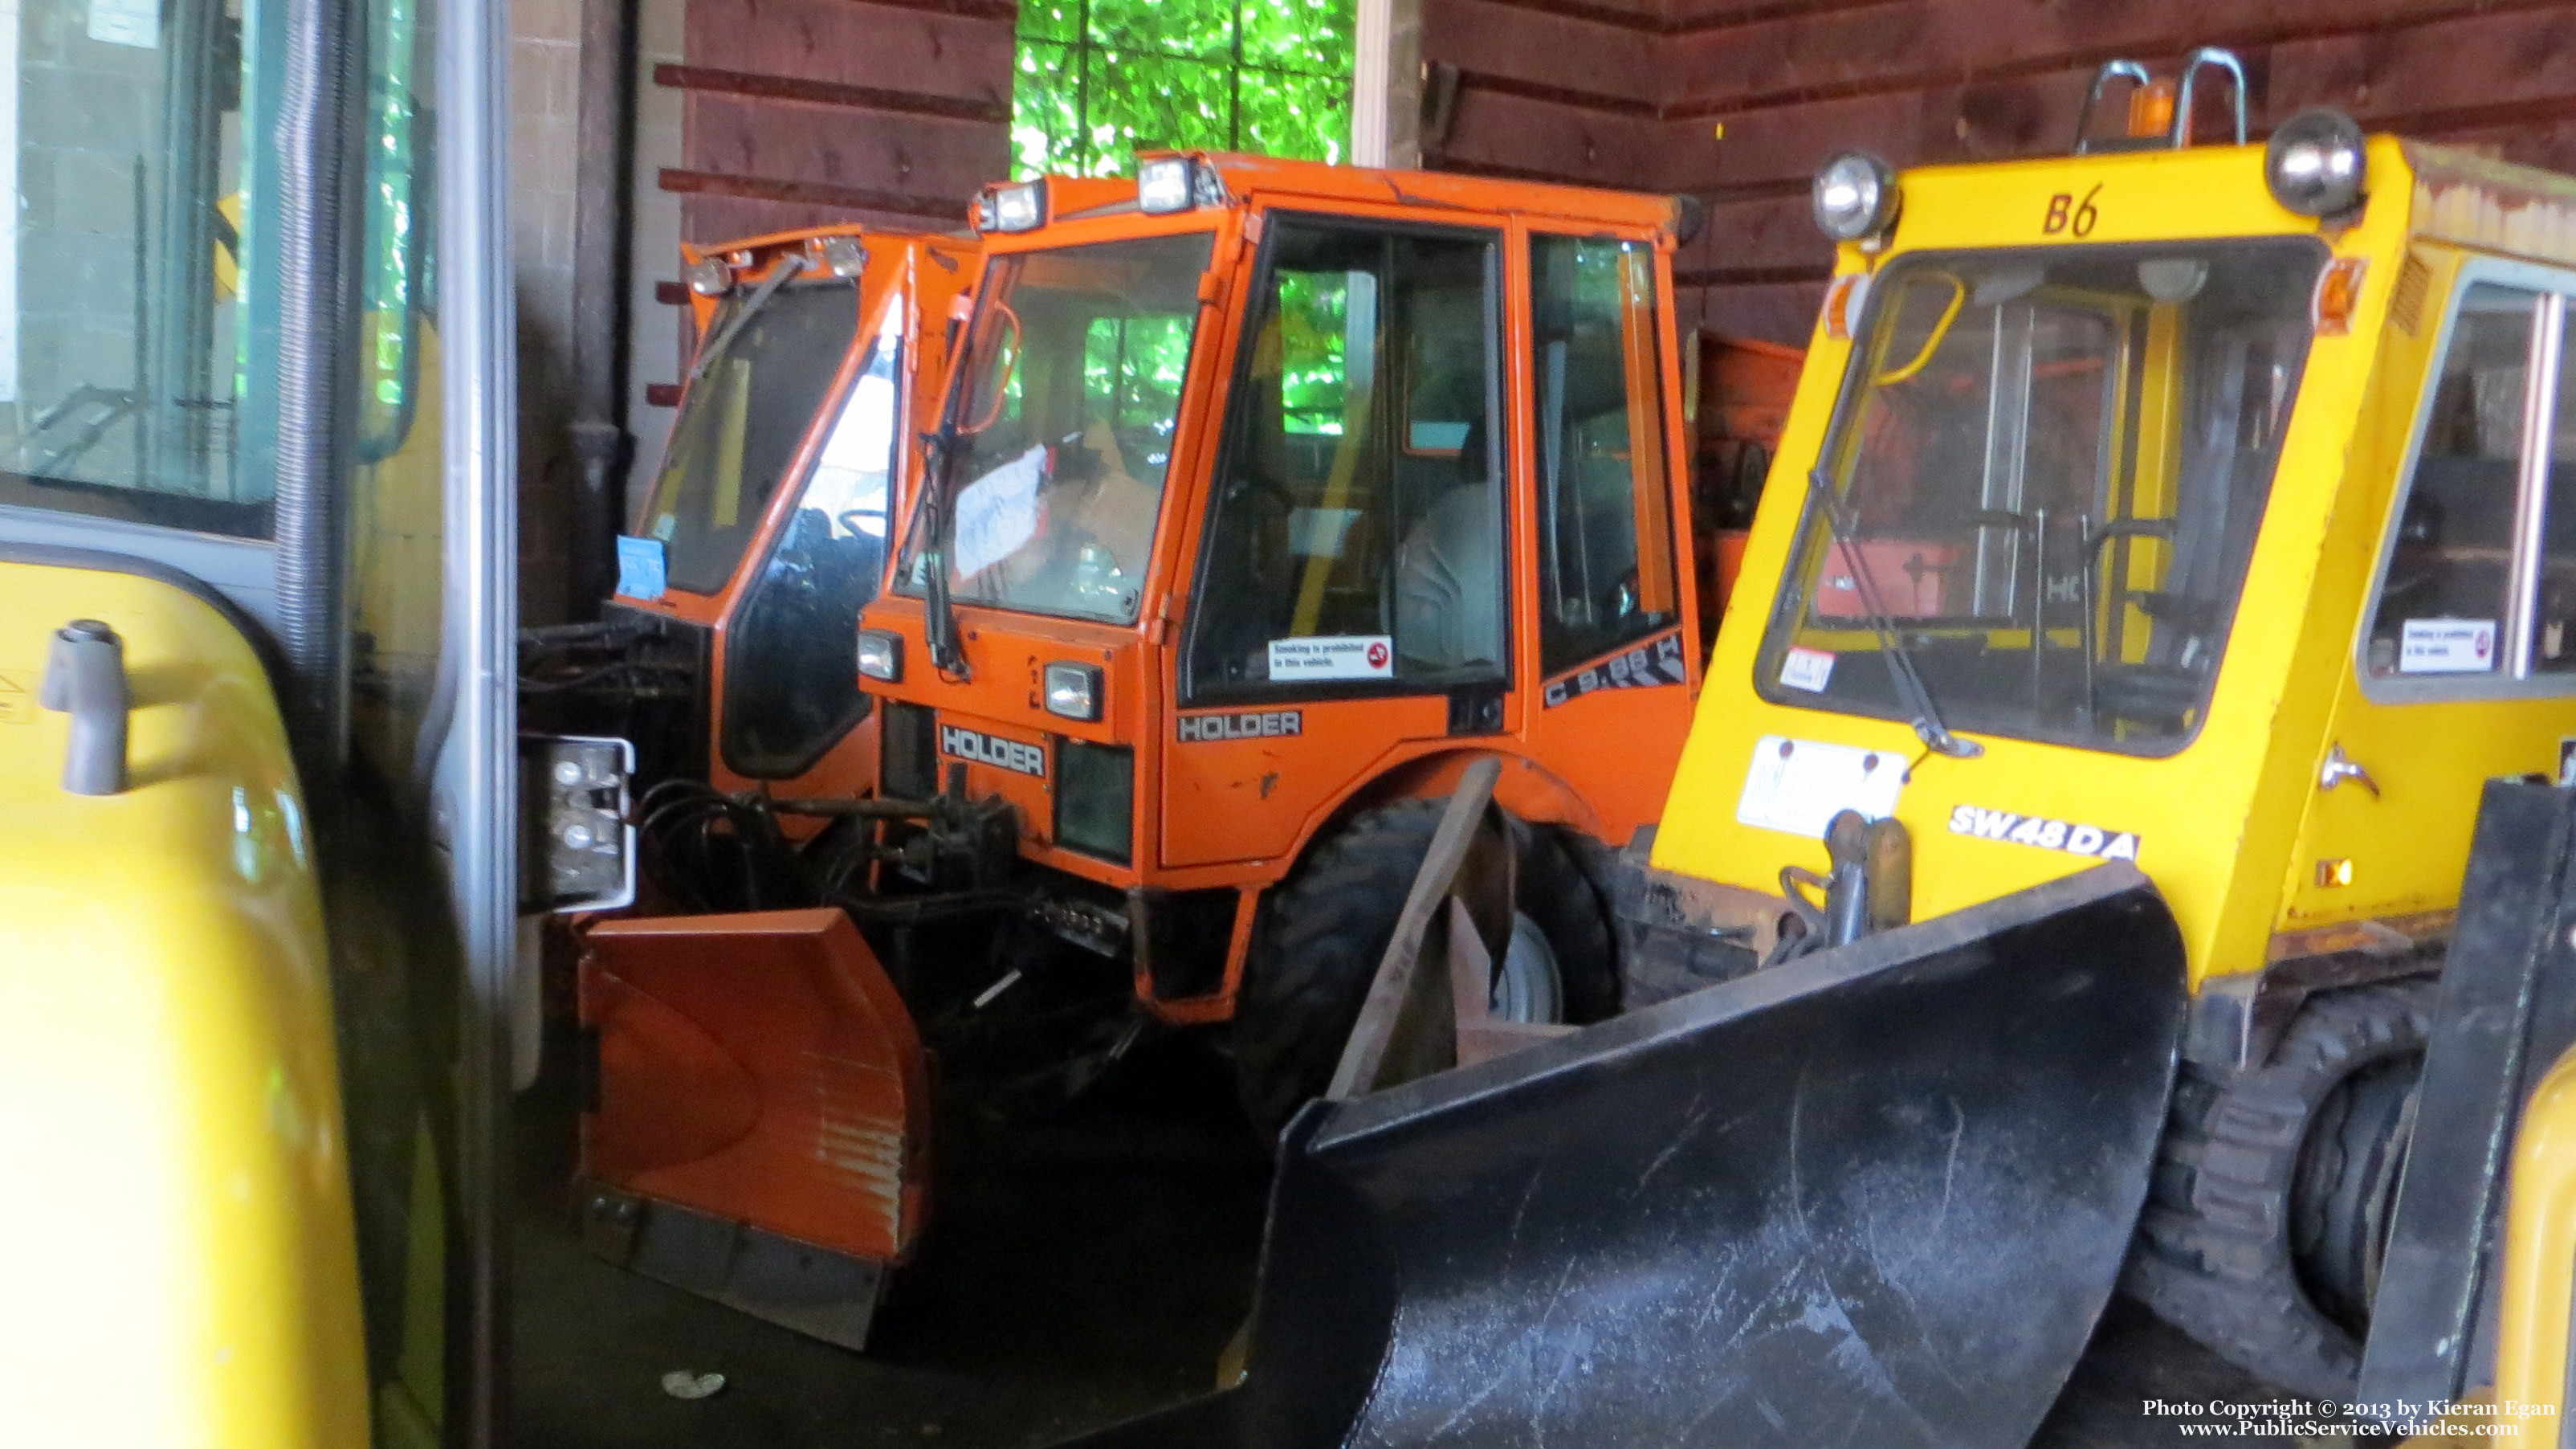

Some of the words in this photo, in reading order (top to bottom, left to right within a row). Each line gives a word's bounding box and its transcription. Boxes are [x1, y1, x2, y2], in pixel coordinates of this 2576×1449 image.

[2043, 182, 2103, 237] B6
[1274, 643, 1310, 655] Smoking
[1323, 643, 1364, 654] prohibited
[1180, 710, 1301, 741] HOLDER
[942, 725, 1044, 777] HOLDER
